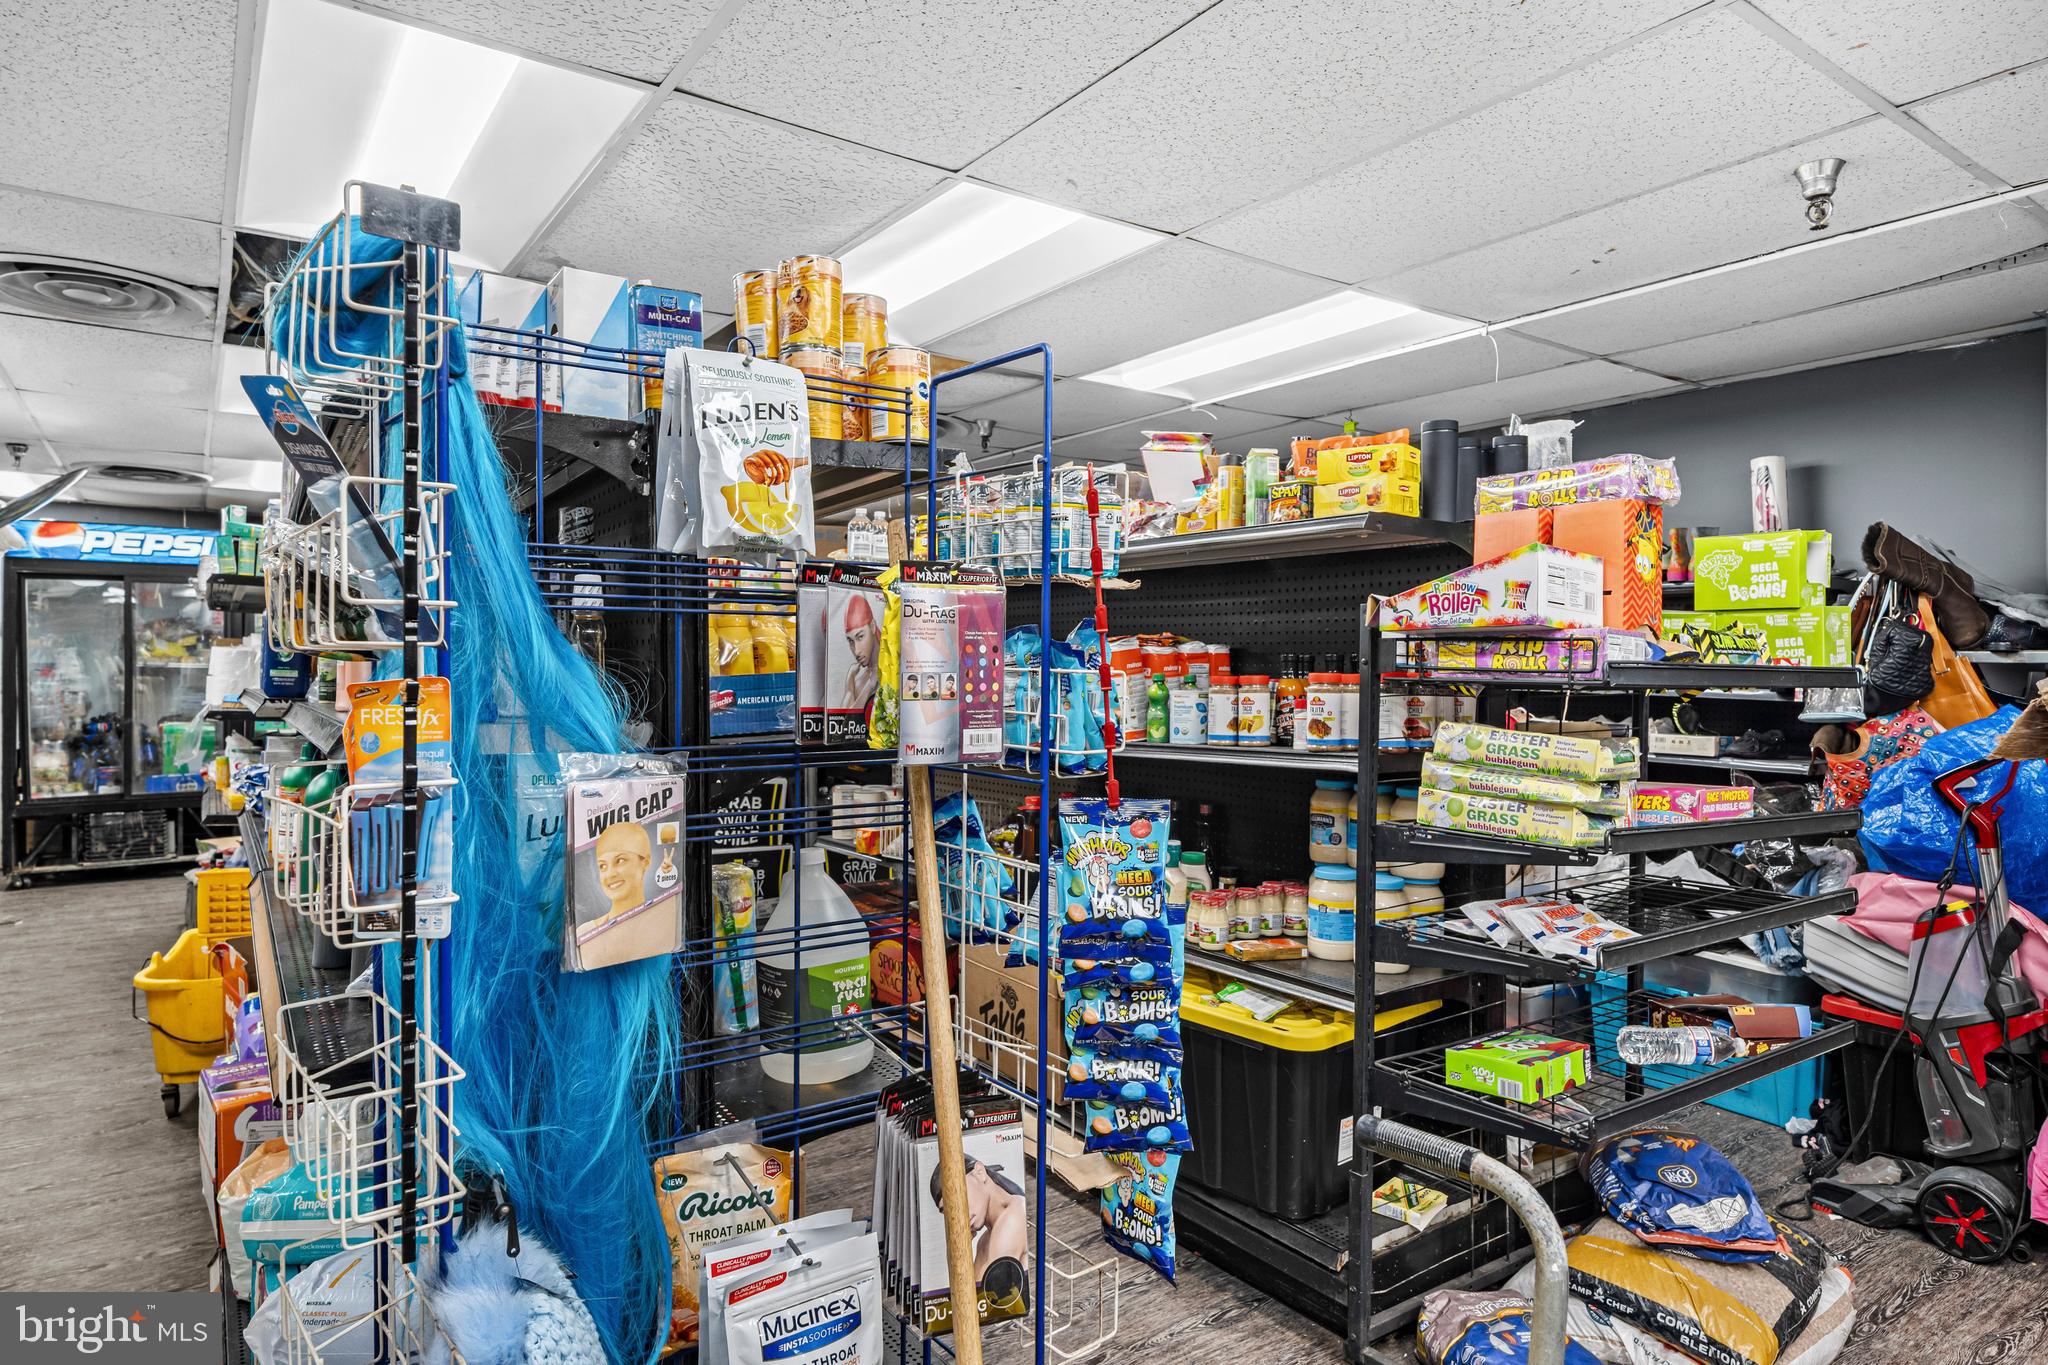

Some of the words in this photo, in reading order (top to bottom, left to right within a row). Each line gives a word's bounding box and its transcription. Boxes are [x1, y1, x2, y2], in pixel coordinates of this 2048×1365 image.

[648, 312, 691, 324] MULTI-CAT
[646, 330, 694, 343] SWITCHING
[759, 427, 792, 448] Lemon
[1347, 453, 1372, 462] LIPTON
[1271, 485, 1301, 499] SPAM
[1338, 486, 1361, 497] LIPTON
[80, 529, 215, 558] PEPSI
[1750, 562, 1779, 574] MEGA
[839, 574, 860, 585] MAXIM
[916, 571, 953, 583] MAXIM
[1750, 573, 1780, 584] SOUR
[1433, 581, 1476, 593] Rainbow
[1427, 592, 1482, 617] Roller
[1775, 636, 1804, 648] MEGA
[1776, 647, 1805, 657] SOUR
[1491, 655, 1548, 671] ROLLS
[737, 696, 769, 705] AMERICAN
[770, 694, 794, 703] FLAVOR
[1488, 729, 1551, 748] EASTER
[915, 747, 945, 756] MAXIM
[1486, 744, 1541, 761] GRASS
[1485, 754, 1538, 770] bubblegum
[1468, 773, 1522, 786] GRASS
[1468, 781, 1520, 795] bubblegum
[1721, 790, 1750, 802] TWISTERS
[586, 802, 613, 818] Deluxe
[587, 804, 630, 839] WIG
[635, 787, 673, 819] CAP
[1467, 796, 1528, 814] EASTER
[1065, 815, 1088, 824] NEW!
[1466, 809, 1520, 827] GRASS
[1466, 820, 1517, 836] bubblegum
[714, 828, 759, 846] SMILE
[1065, 837, 1130, 866] WARHEADS
[842, 860, 877, 872] GRAB
[661, 873, 677, 883] pieces
[843, 868, 877, 884] SNACK
[1116, 870, 1153, 885] MEGA
[1118, 885, 1153, 897] SOUR
[833, 976, 867, 992] TORCH
[836, 988, 865, 1003] FUEL
[1131, 988, 1166, 1001] SOUR
[1103, 999, 1173, 1023] BOOMS!
[1091, 1059, 1160, 1082] BOOMS!
[979, 1115, 1007, 1124] SUPERIOR
[1002, 1134, 1022, 1144] MAXIM
[679, 1185, 775, 1222] Ricola
[1135, 1192, 1156, 1215] MEGA
[1133, 1207, 1154, 1227] SOUR
[689, 1226, 733, 1244] THROAT
[737, 1218, 766, 1235] BALM
[1115, 1207, 1163, 1247] BOOMS!
[716, 1256, 746, 1269] CLINICALLY
[746, 1251, 768, 1263] PROVEN
[734, 1283, 763, 1297] CLINICALLY
[762, 1274, 784, 1287] PROVEN
[1606, 1298, 1634, 1315] CHEF
[762, 1293, 857, 1341] Mucinex
